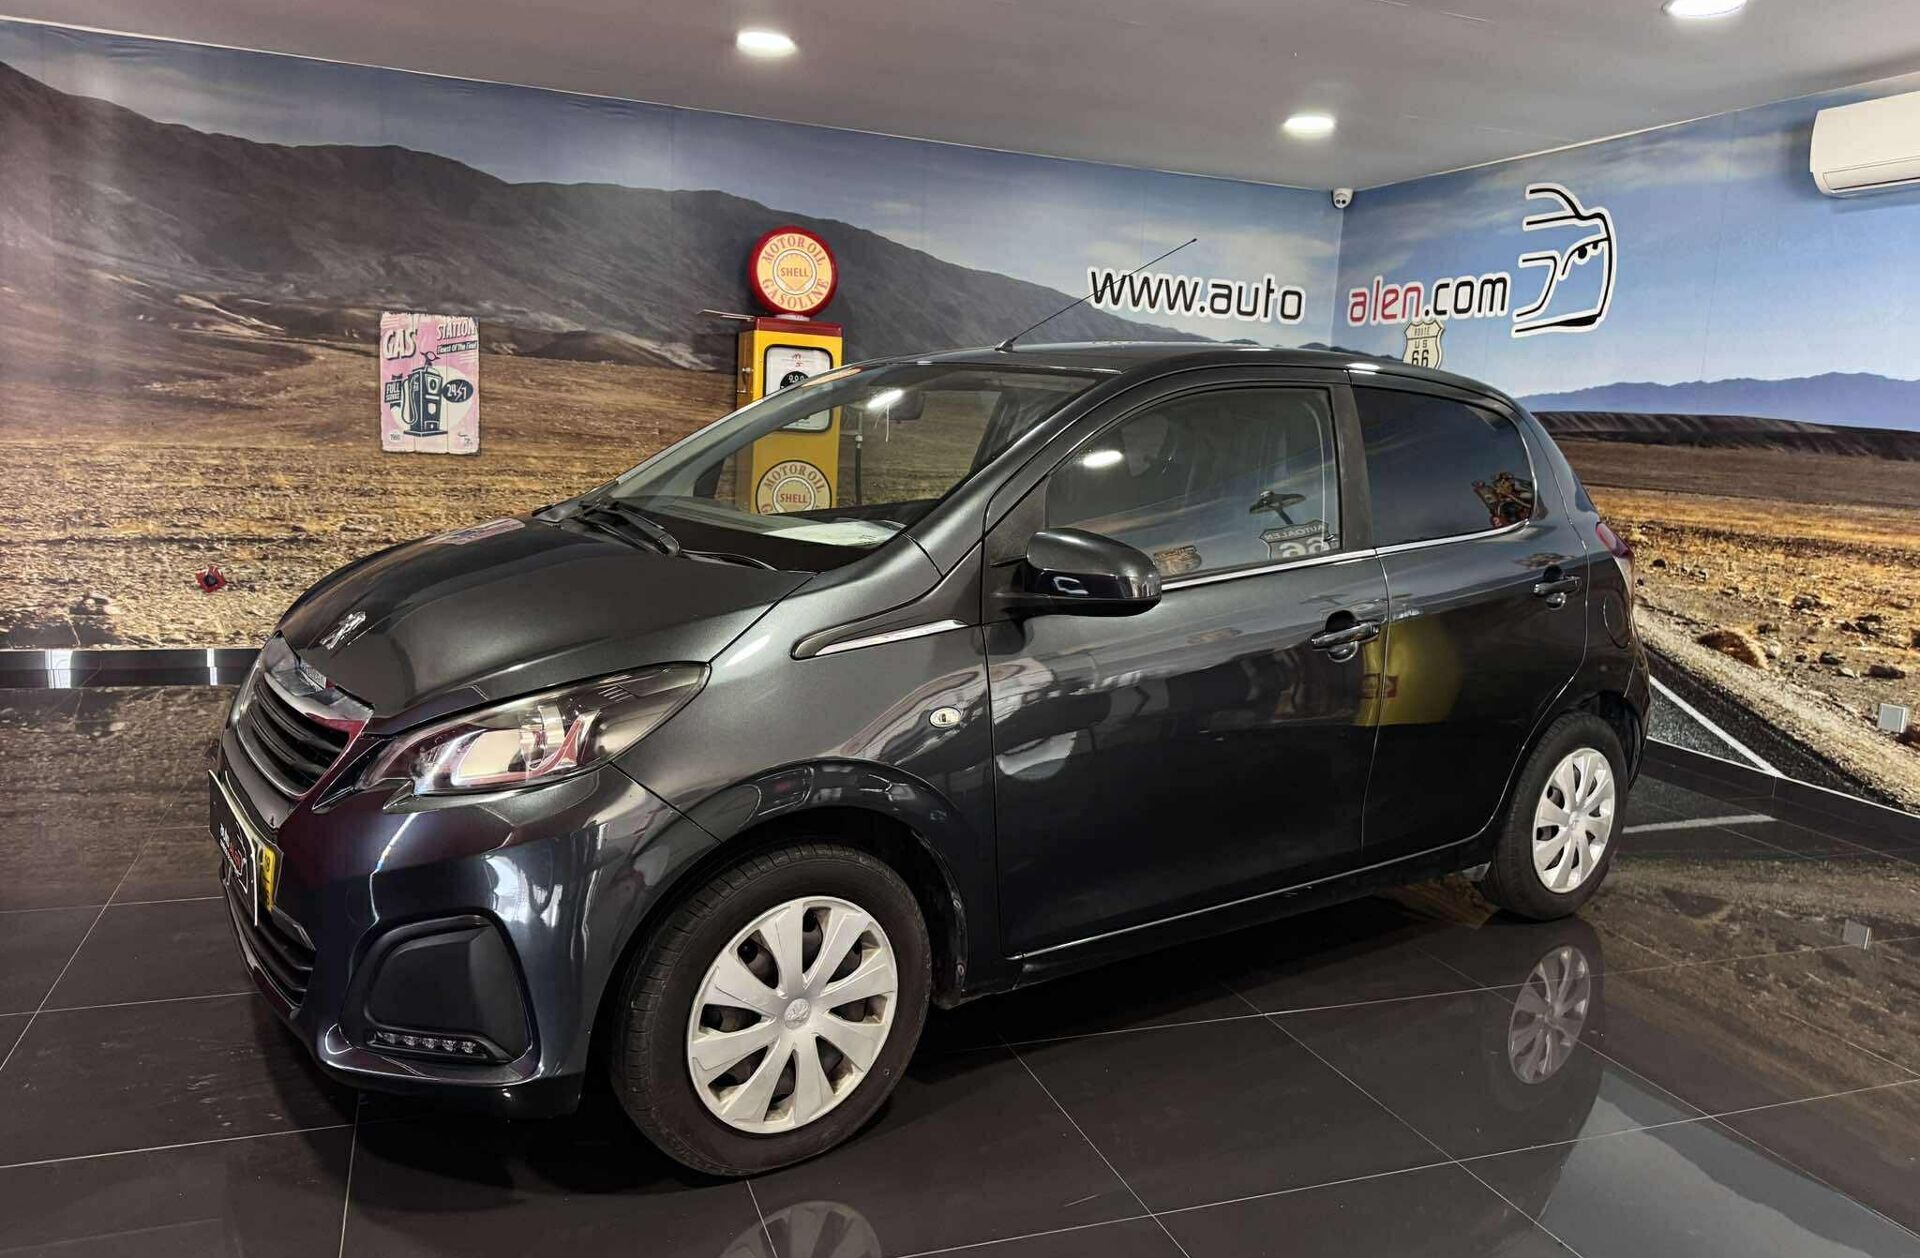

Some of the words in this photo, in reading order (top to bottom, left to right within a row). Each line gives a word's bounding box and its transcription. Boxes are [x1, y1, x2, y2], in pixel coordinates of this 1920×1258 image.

[762, 235, 805, 264] MOTOR
[807, 242, 826, 266] OIL
[780, 267, 809, 278] SHELL
[762, 278, 829, 309] GASOLINE
[1091, 271, 1303, 321] www.auto
[1350, 276, 1508, 323] alen.com
[437, 318, 477, 341] STATION
[1414, 327, 1431, 336] ROUTE
[383, 328, 418, 361] GAS
[1412, 349, 1430, 368] 66
[386, 383, 400, 395] FULL
[764, 464, 807, 491] MOTOR
[807, 470, 826, 493] OIL
[780, 493, 808, 504] SHELL
